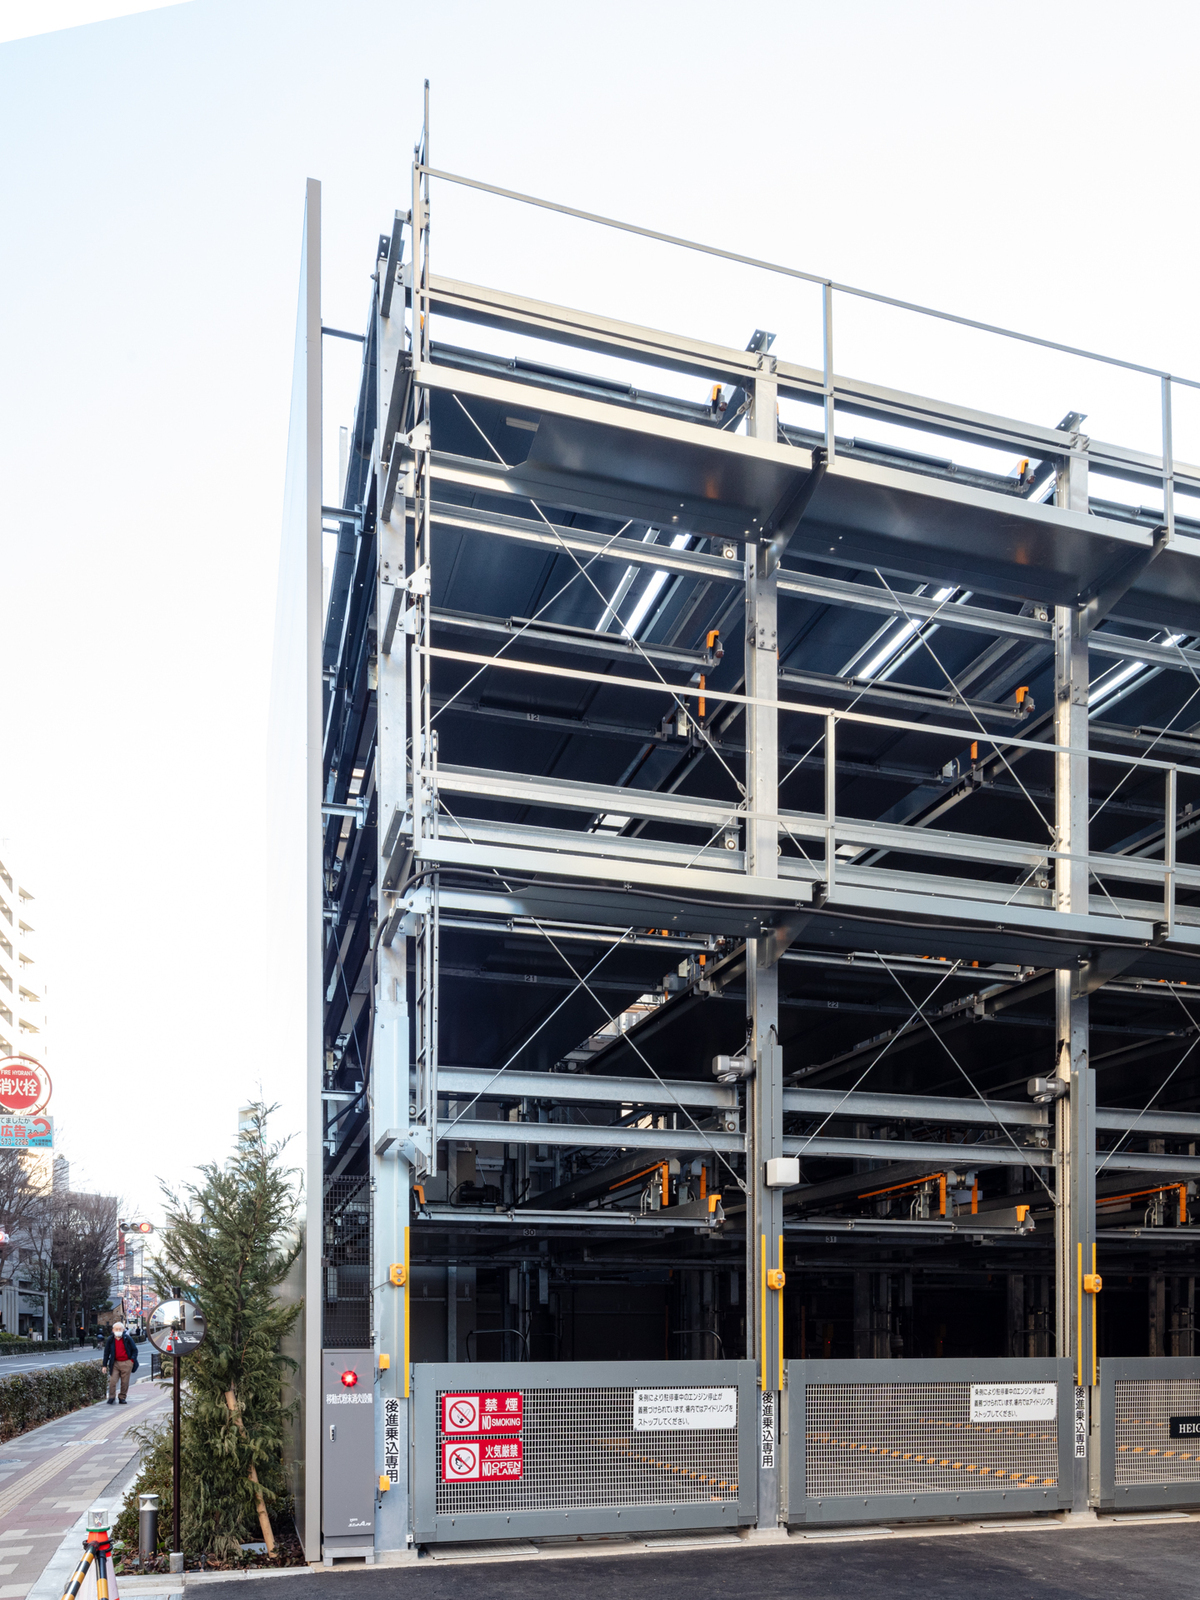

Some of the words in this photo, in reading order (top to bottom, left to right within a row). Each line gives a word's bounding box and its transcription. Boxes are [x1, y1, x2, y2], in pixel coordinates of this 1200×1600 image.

[0, 1078, 38, 1096] 消火栓
[1, 1124, 26, 1138] 広告
[485, 1398, 518, 1412] 禁煙
[482, 1416, 491, 1430] NO
[491, 1418, 520, 1427] SMOKING
[762, 1392, 774, 1467] 後進乗込専用
[1075, 1387, 1085, 1457] 後進乗込専用
[385, 1399, 399, 1482] 後進乗込専用
[485, 1444, 518, 1458] 火気厳禁
[482, 1462, 491, 1476] NO
[492, 1461, 520, 1469] OPEN
